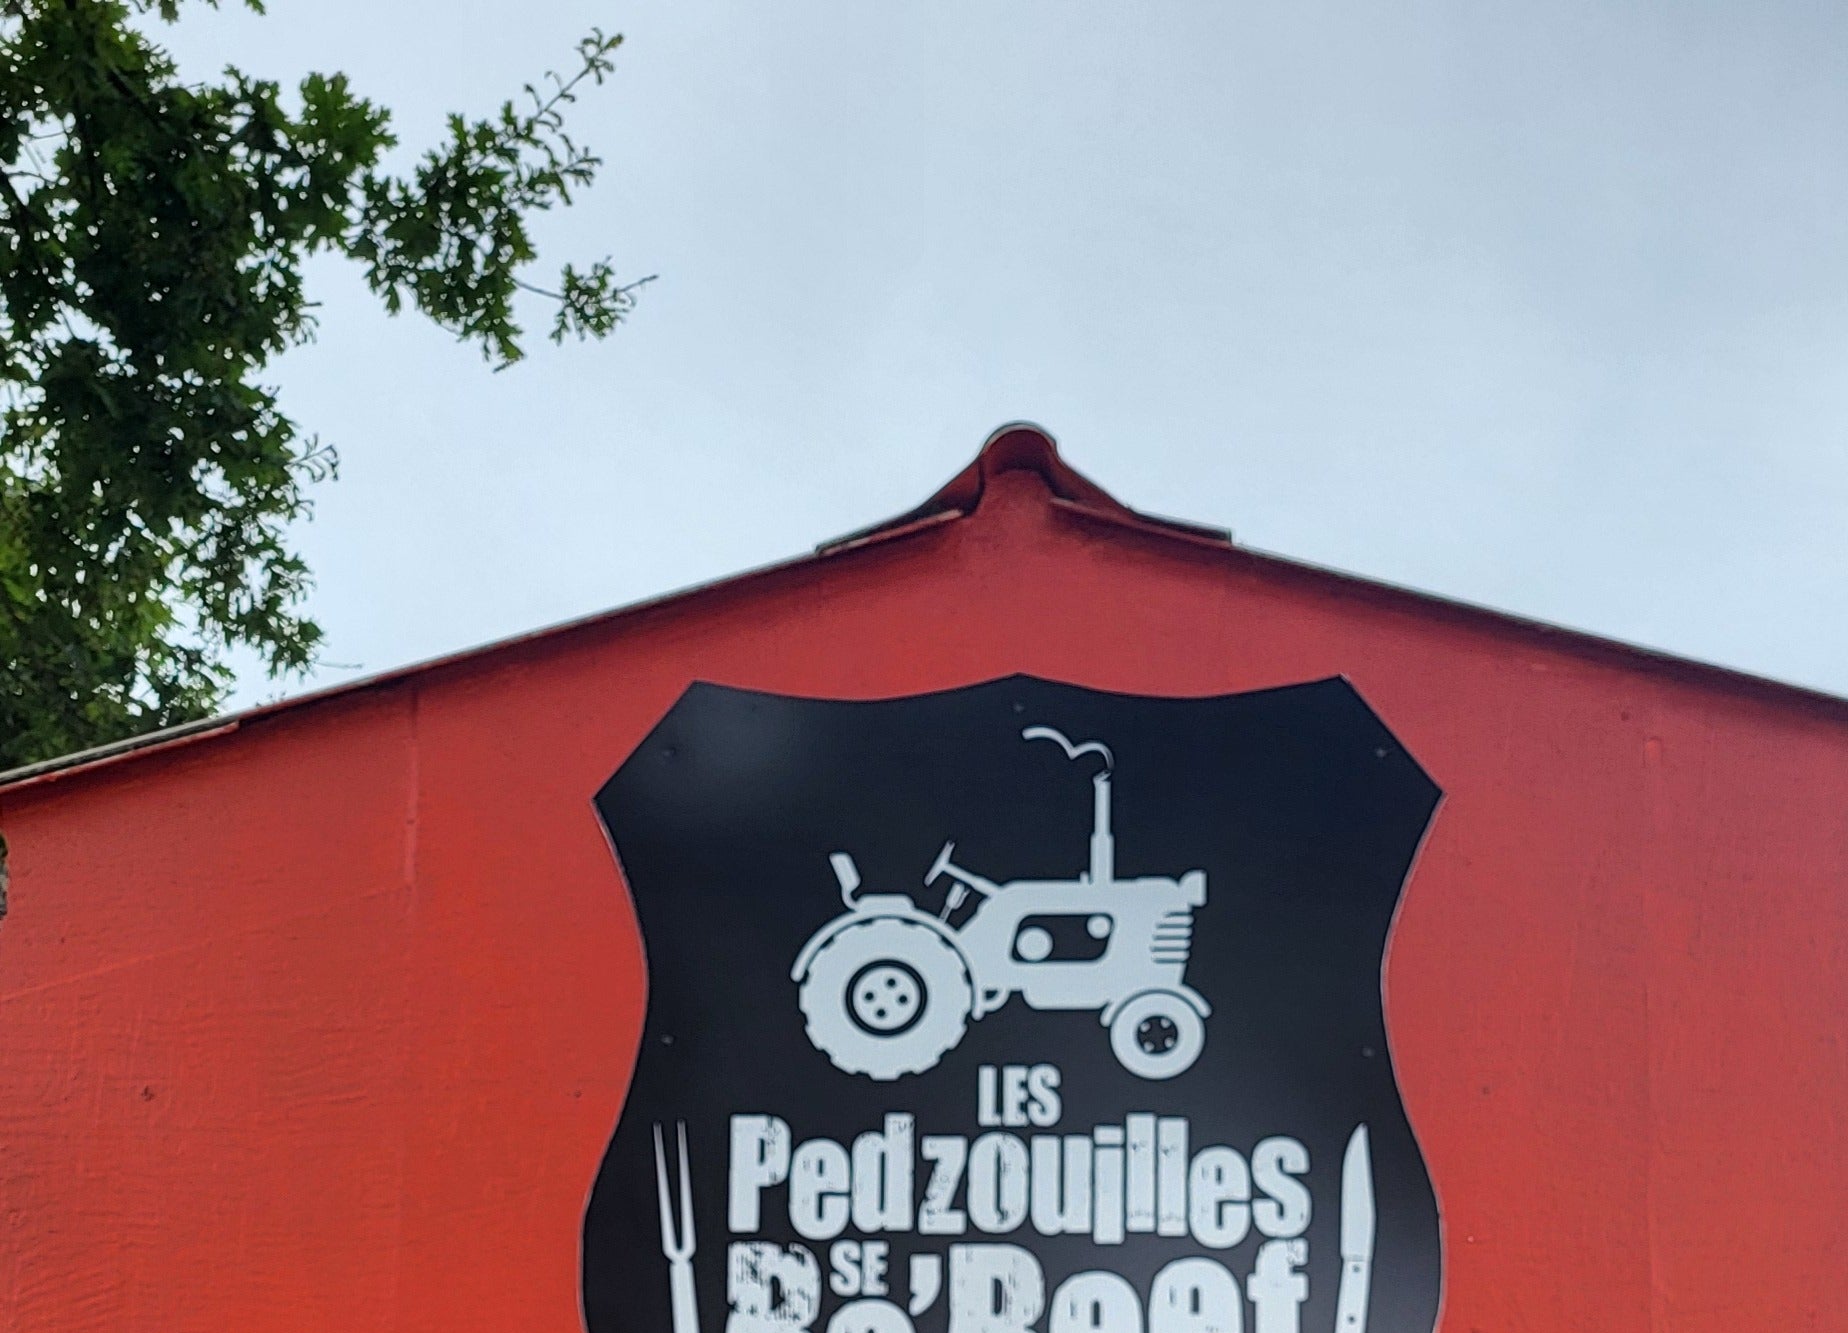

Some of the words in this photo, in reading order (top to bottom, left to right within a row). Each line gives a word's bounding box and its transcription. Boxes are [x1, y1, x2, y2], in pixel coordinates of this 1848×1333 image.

[977, 1063, 1061, 1128] LES
[727, 1112, 1312, 1249] Pedzouilles
[829, 1240, 890, 1297] SE
